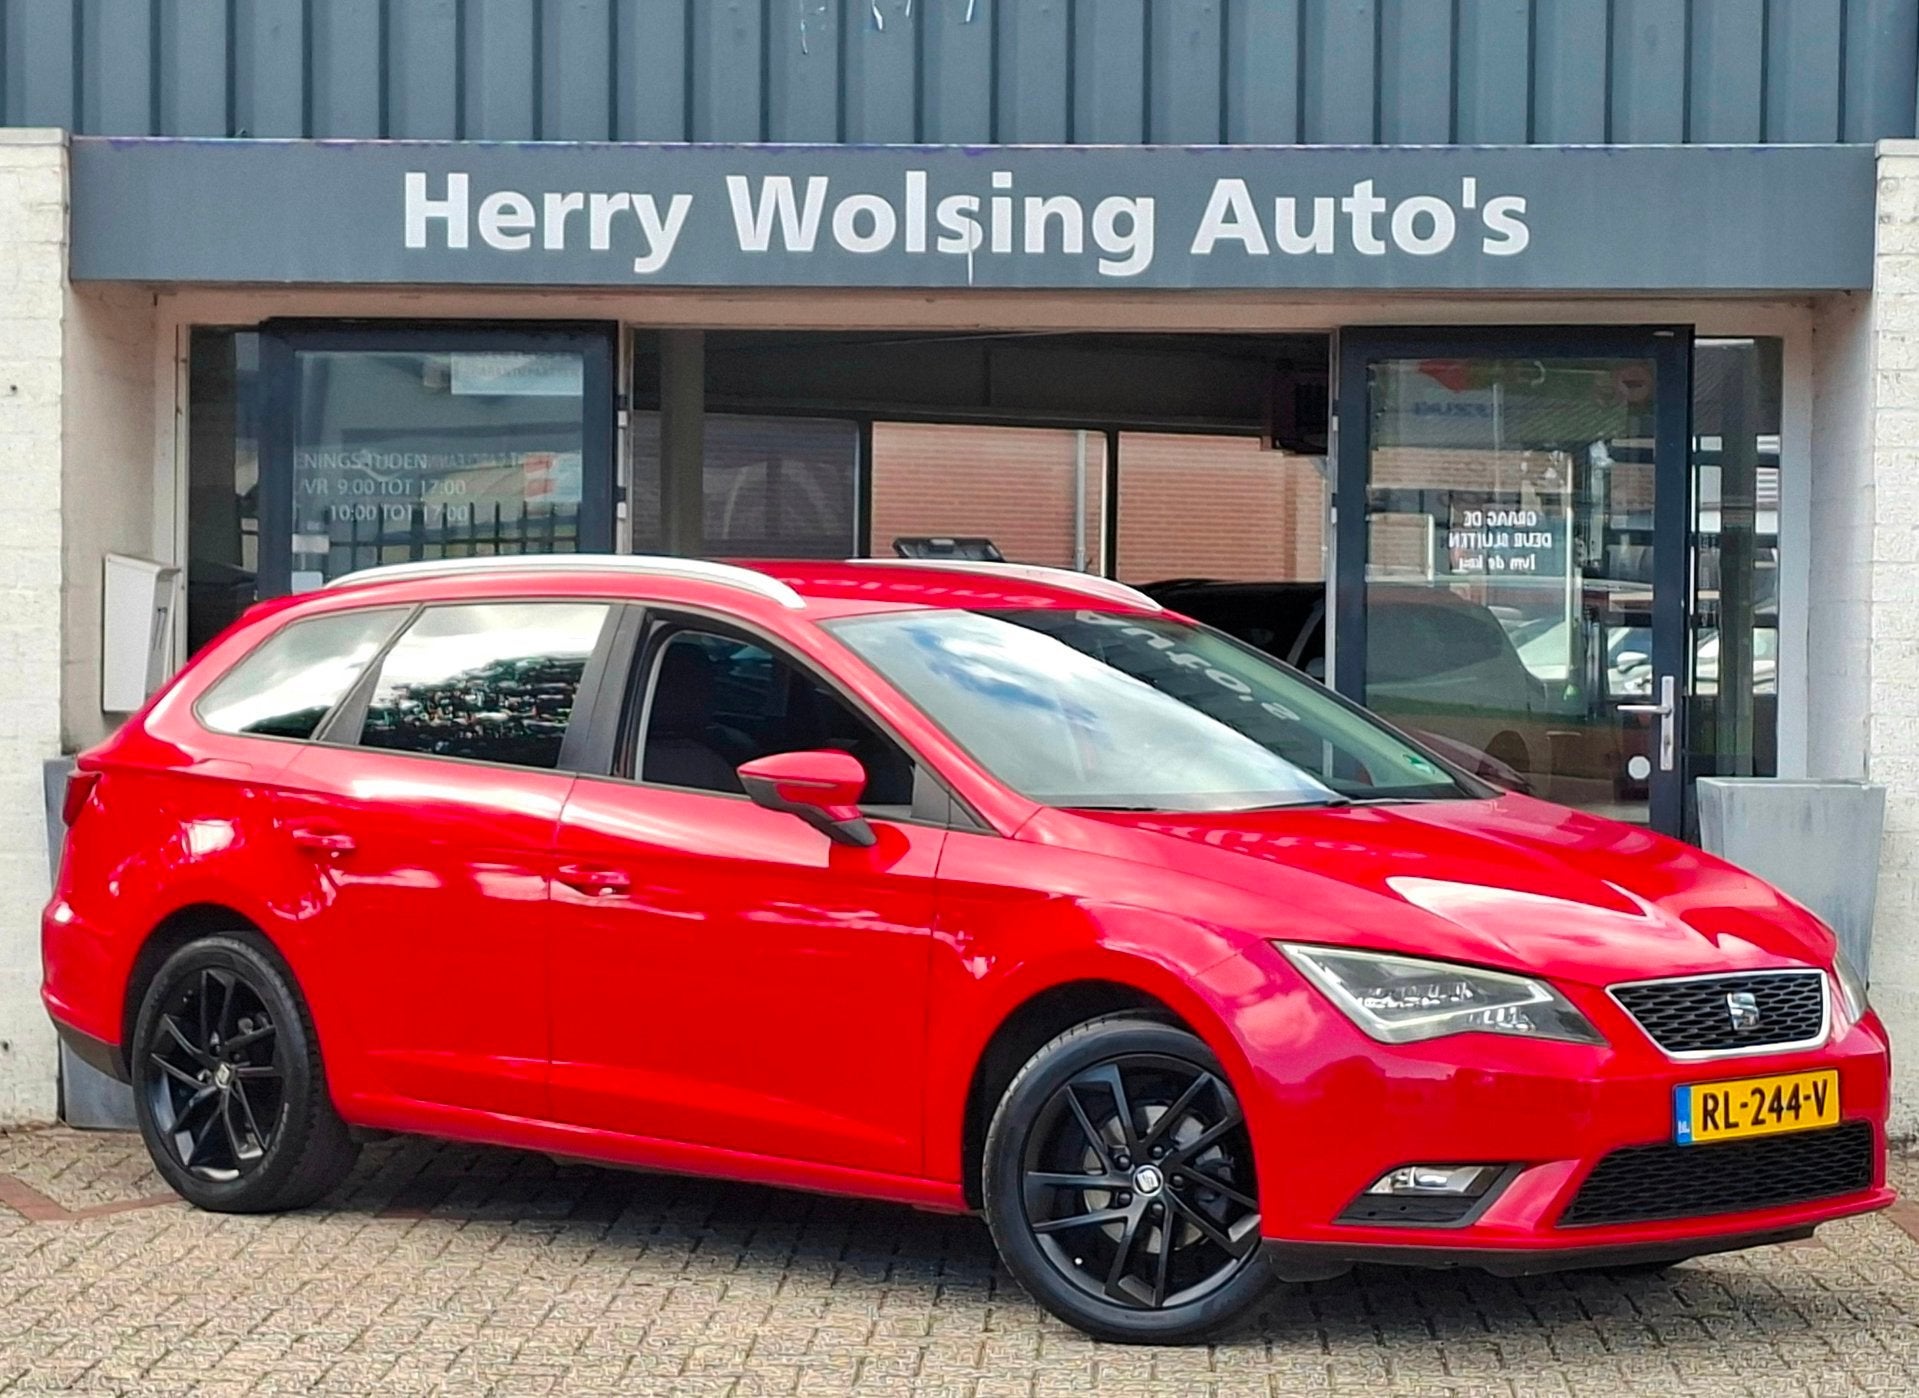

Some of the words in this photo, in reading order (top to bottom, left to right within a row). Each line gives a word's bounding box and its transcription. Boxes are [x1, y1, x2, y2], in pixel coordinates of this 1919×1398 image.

[405, 172, 693, 273] Herry
[726, 171, 1156, 276] Wolsing
[1190, 177, 1531, 256] Auto's
[380, 478, 416, 496] TOT
[380, 504, 413, 522] TOT
[1702, 1078, 1828, 1132] RL-244-V
